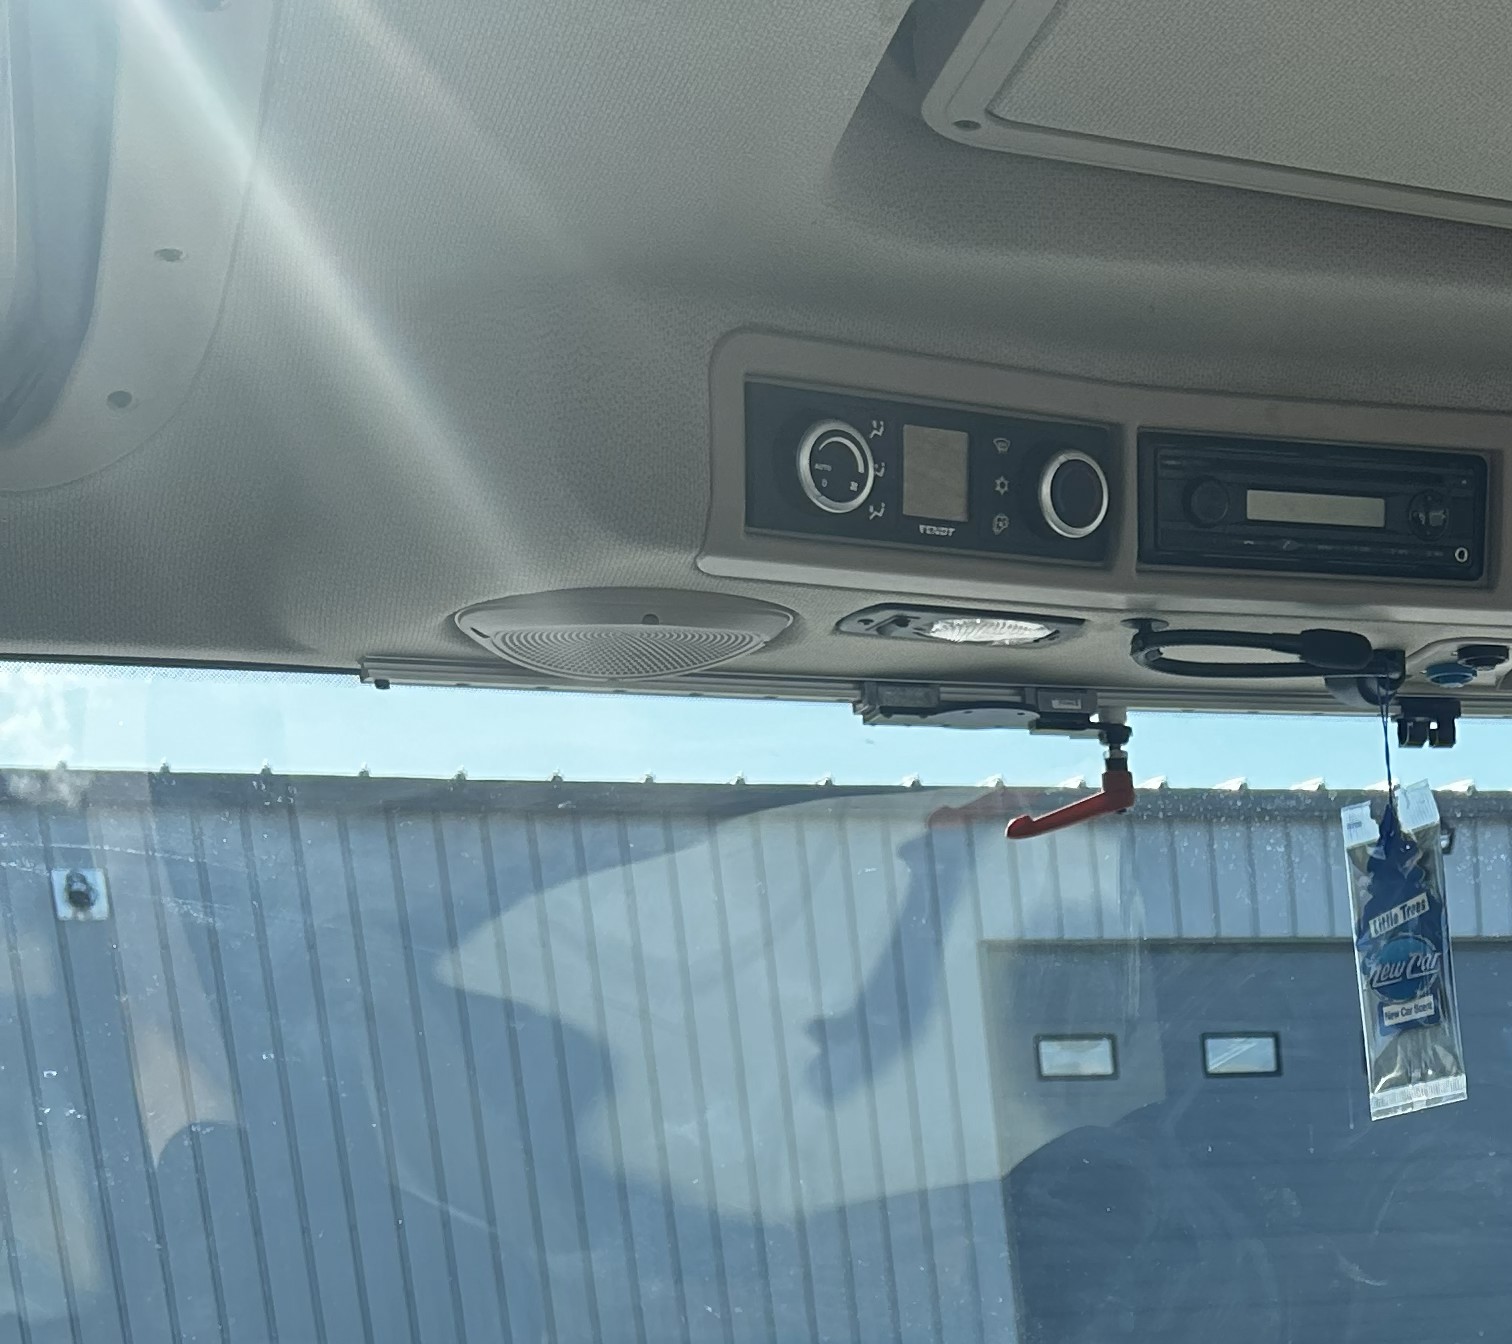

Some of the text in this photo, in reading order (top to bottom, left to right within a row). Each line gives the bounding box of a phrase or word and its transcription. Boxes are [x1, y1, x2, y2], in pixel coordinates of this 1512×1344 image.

[918, 524, 956, 536] FENDT
[1373, 898, 1427, 935] Little Trees
[1384, 1001, 1432, 1021] New Car Scent
